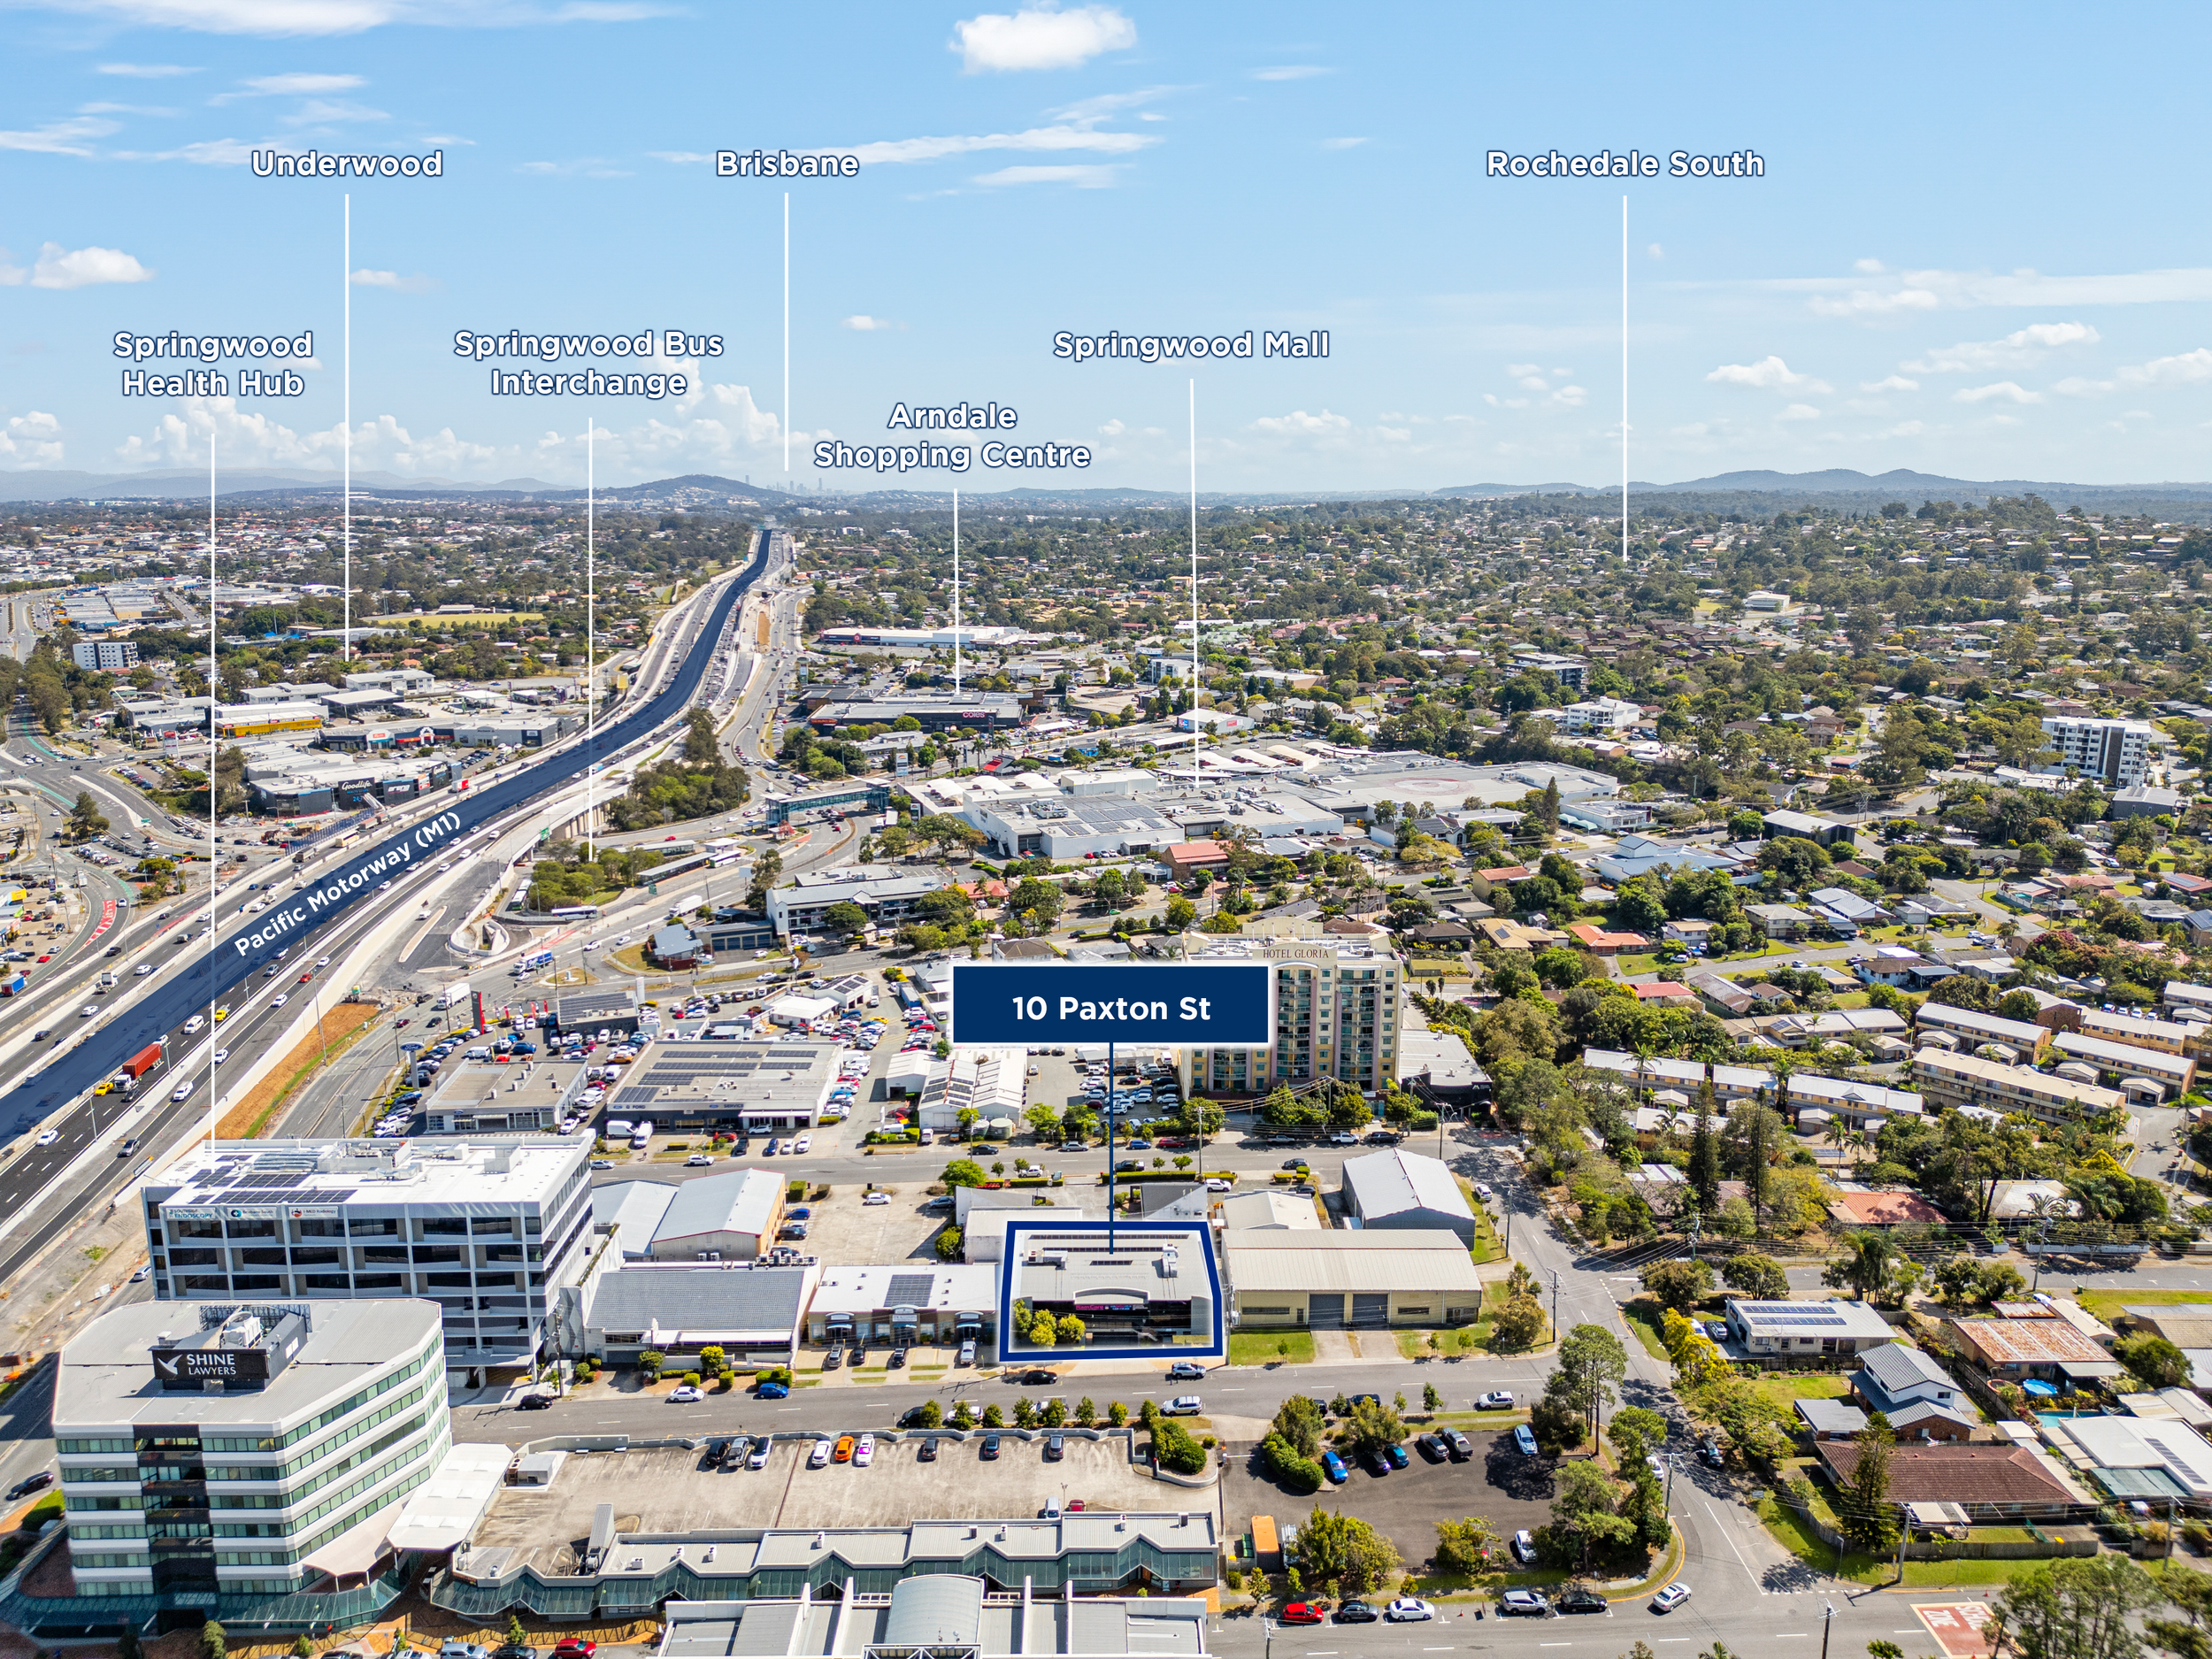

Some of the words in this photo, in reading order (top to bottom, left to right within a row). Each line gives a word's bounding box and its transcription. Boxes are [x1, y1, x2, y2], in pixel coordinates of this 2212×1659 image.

[1263, 949, 1292, 958] HOTEL
[1294, 949, 1329, 958] GLORIA
[187, 1354, 235, 1365] SHINE
